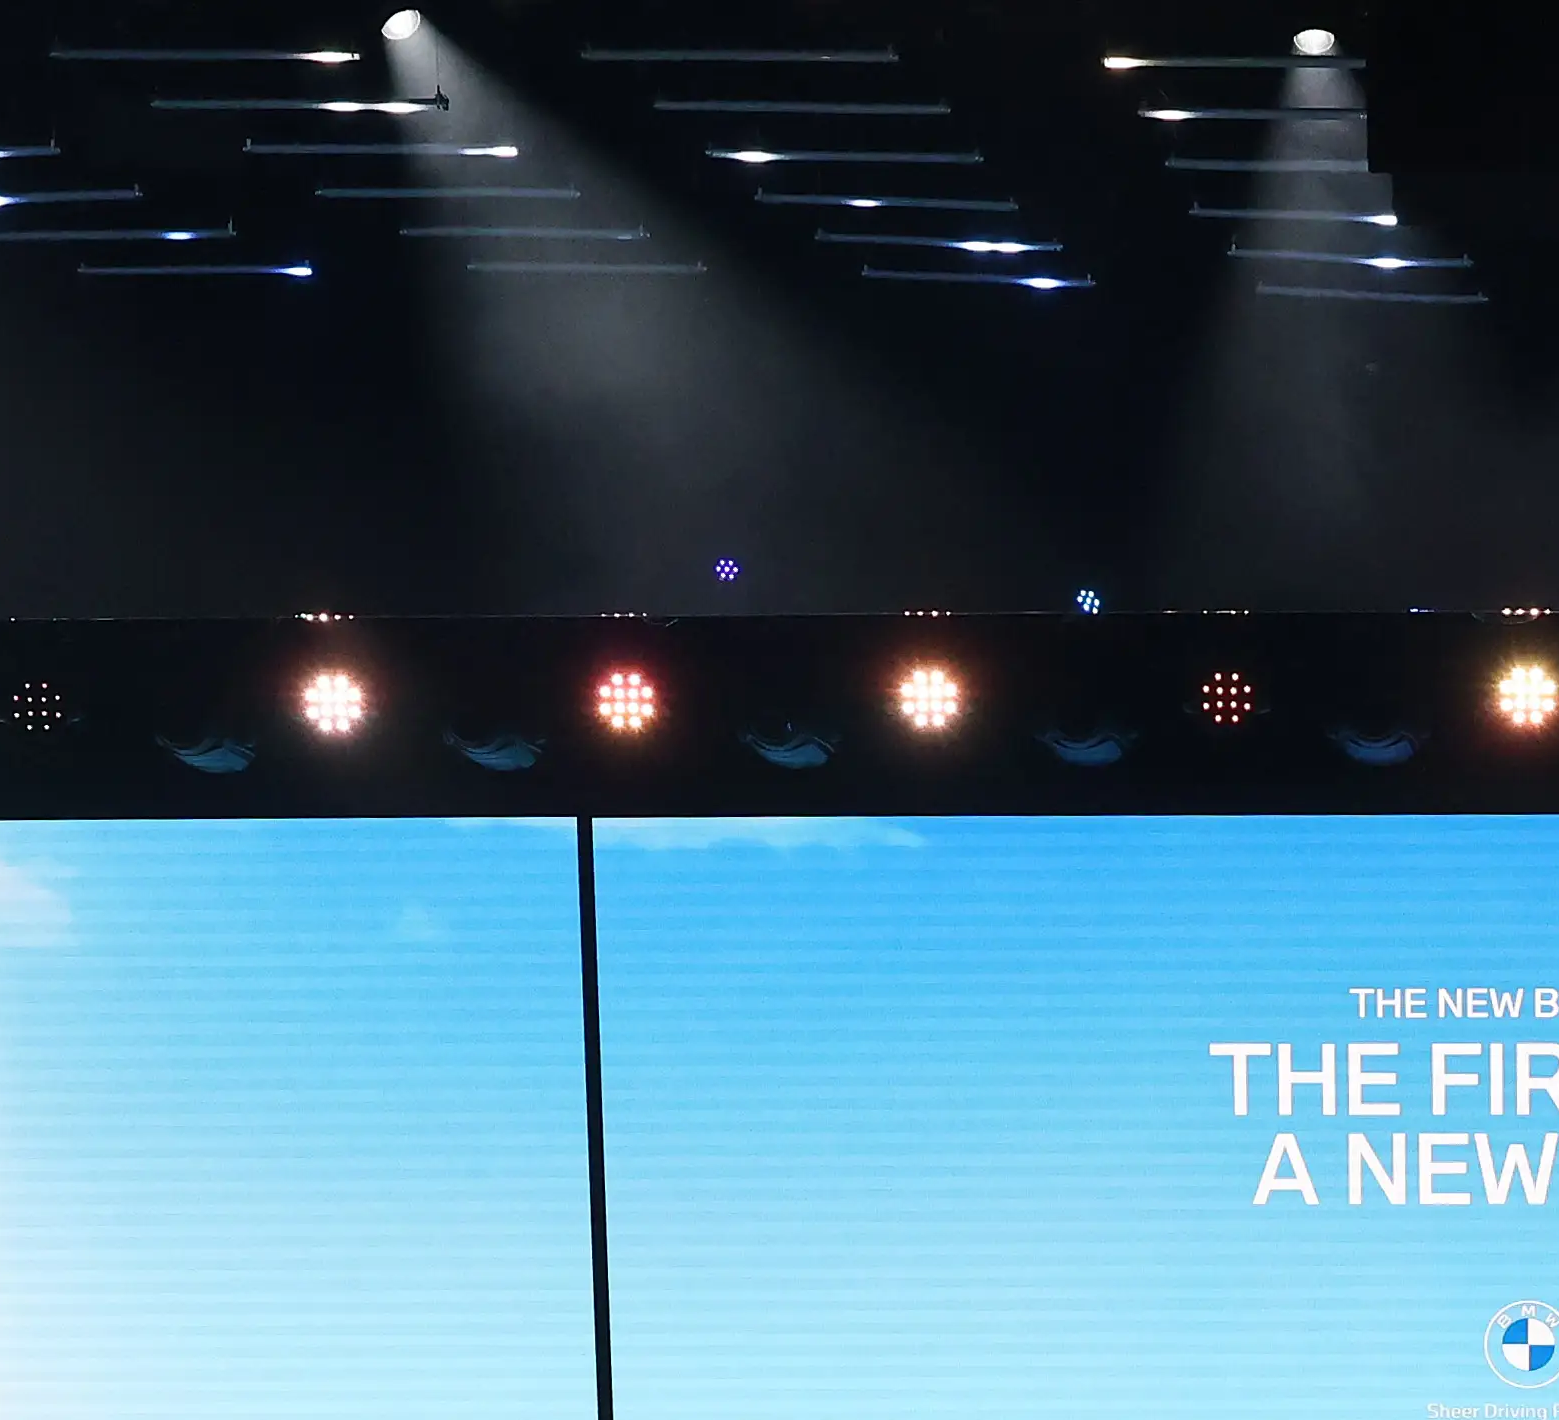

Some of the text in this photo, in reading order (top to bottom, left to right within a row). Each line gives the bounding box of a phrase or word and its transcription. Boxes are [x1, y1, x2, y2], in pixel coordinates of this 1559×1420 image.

[1349, 987, 1427, 1019] THE
[1438, 987, 1524, 1019] NEW
[1209, 1041, 1401, 1117] THE
[1252, 1132, 1320, 1206] A
[1348, 1132, 1559, 1206] NEW
[1427, 1403, 1479, 1420] Sheer
